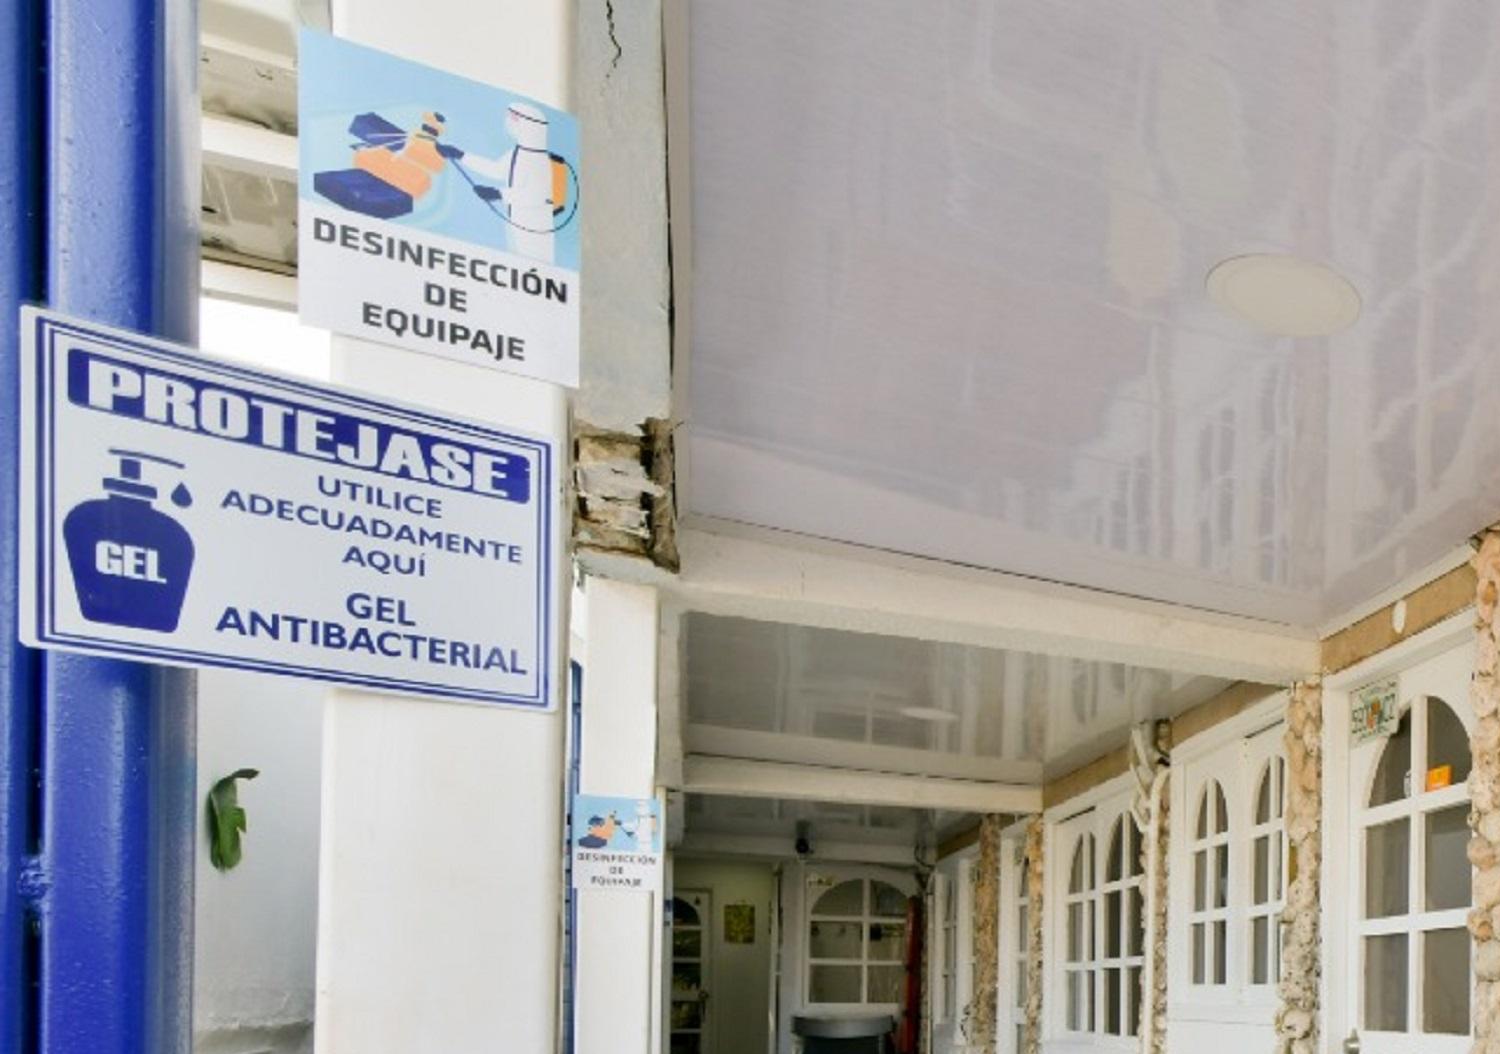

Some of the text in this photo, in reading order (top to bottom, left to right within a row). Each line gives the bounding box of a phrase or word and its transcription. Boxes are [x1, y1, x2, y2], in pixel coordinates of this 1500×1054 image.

[312, 216, 569, 304] DESINFECCIÓN
[423, 281, 468, 313] DE
[361, 301, 526, 362] EQUIPAJE
[86, 358, 511, 499] PROTEJASE
[316, 474, 443, 520] UTILICE
[219, 489, 523, 565] ADECUADAMENTE
[94, 539, 168, 585] GEL
[341, 546, 427, 578] AQUÍ
[345, 592, 417, 628] GEL
[214, 606, 528, 676] ANTIBACTERIAL
